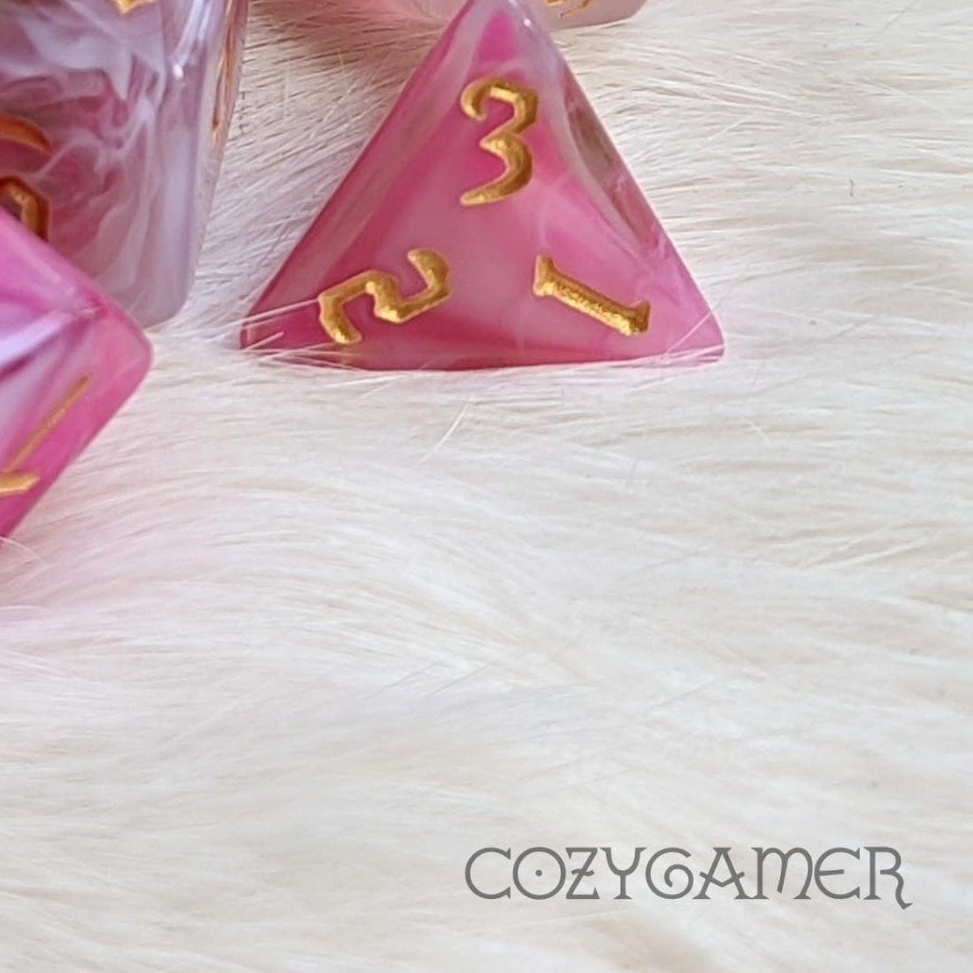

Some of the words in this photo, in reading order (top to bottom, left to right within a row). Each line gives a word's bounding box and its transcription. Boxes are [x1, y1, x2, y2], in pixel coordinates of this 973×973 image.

[460, 77, 538, 206] 3
[318, 247, 451, 345] 2
[533, 253, 651, 337] 1
